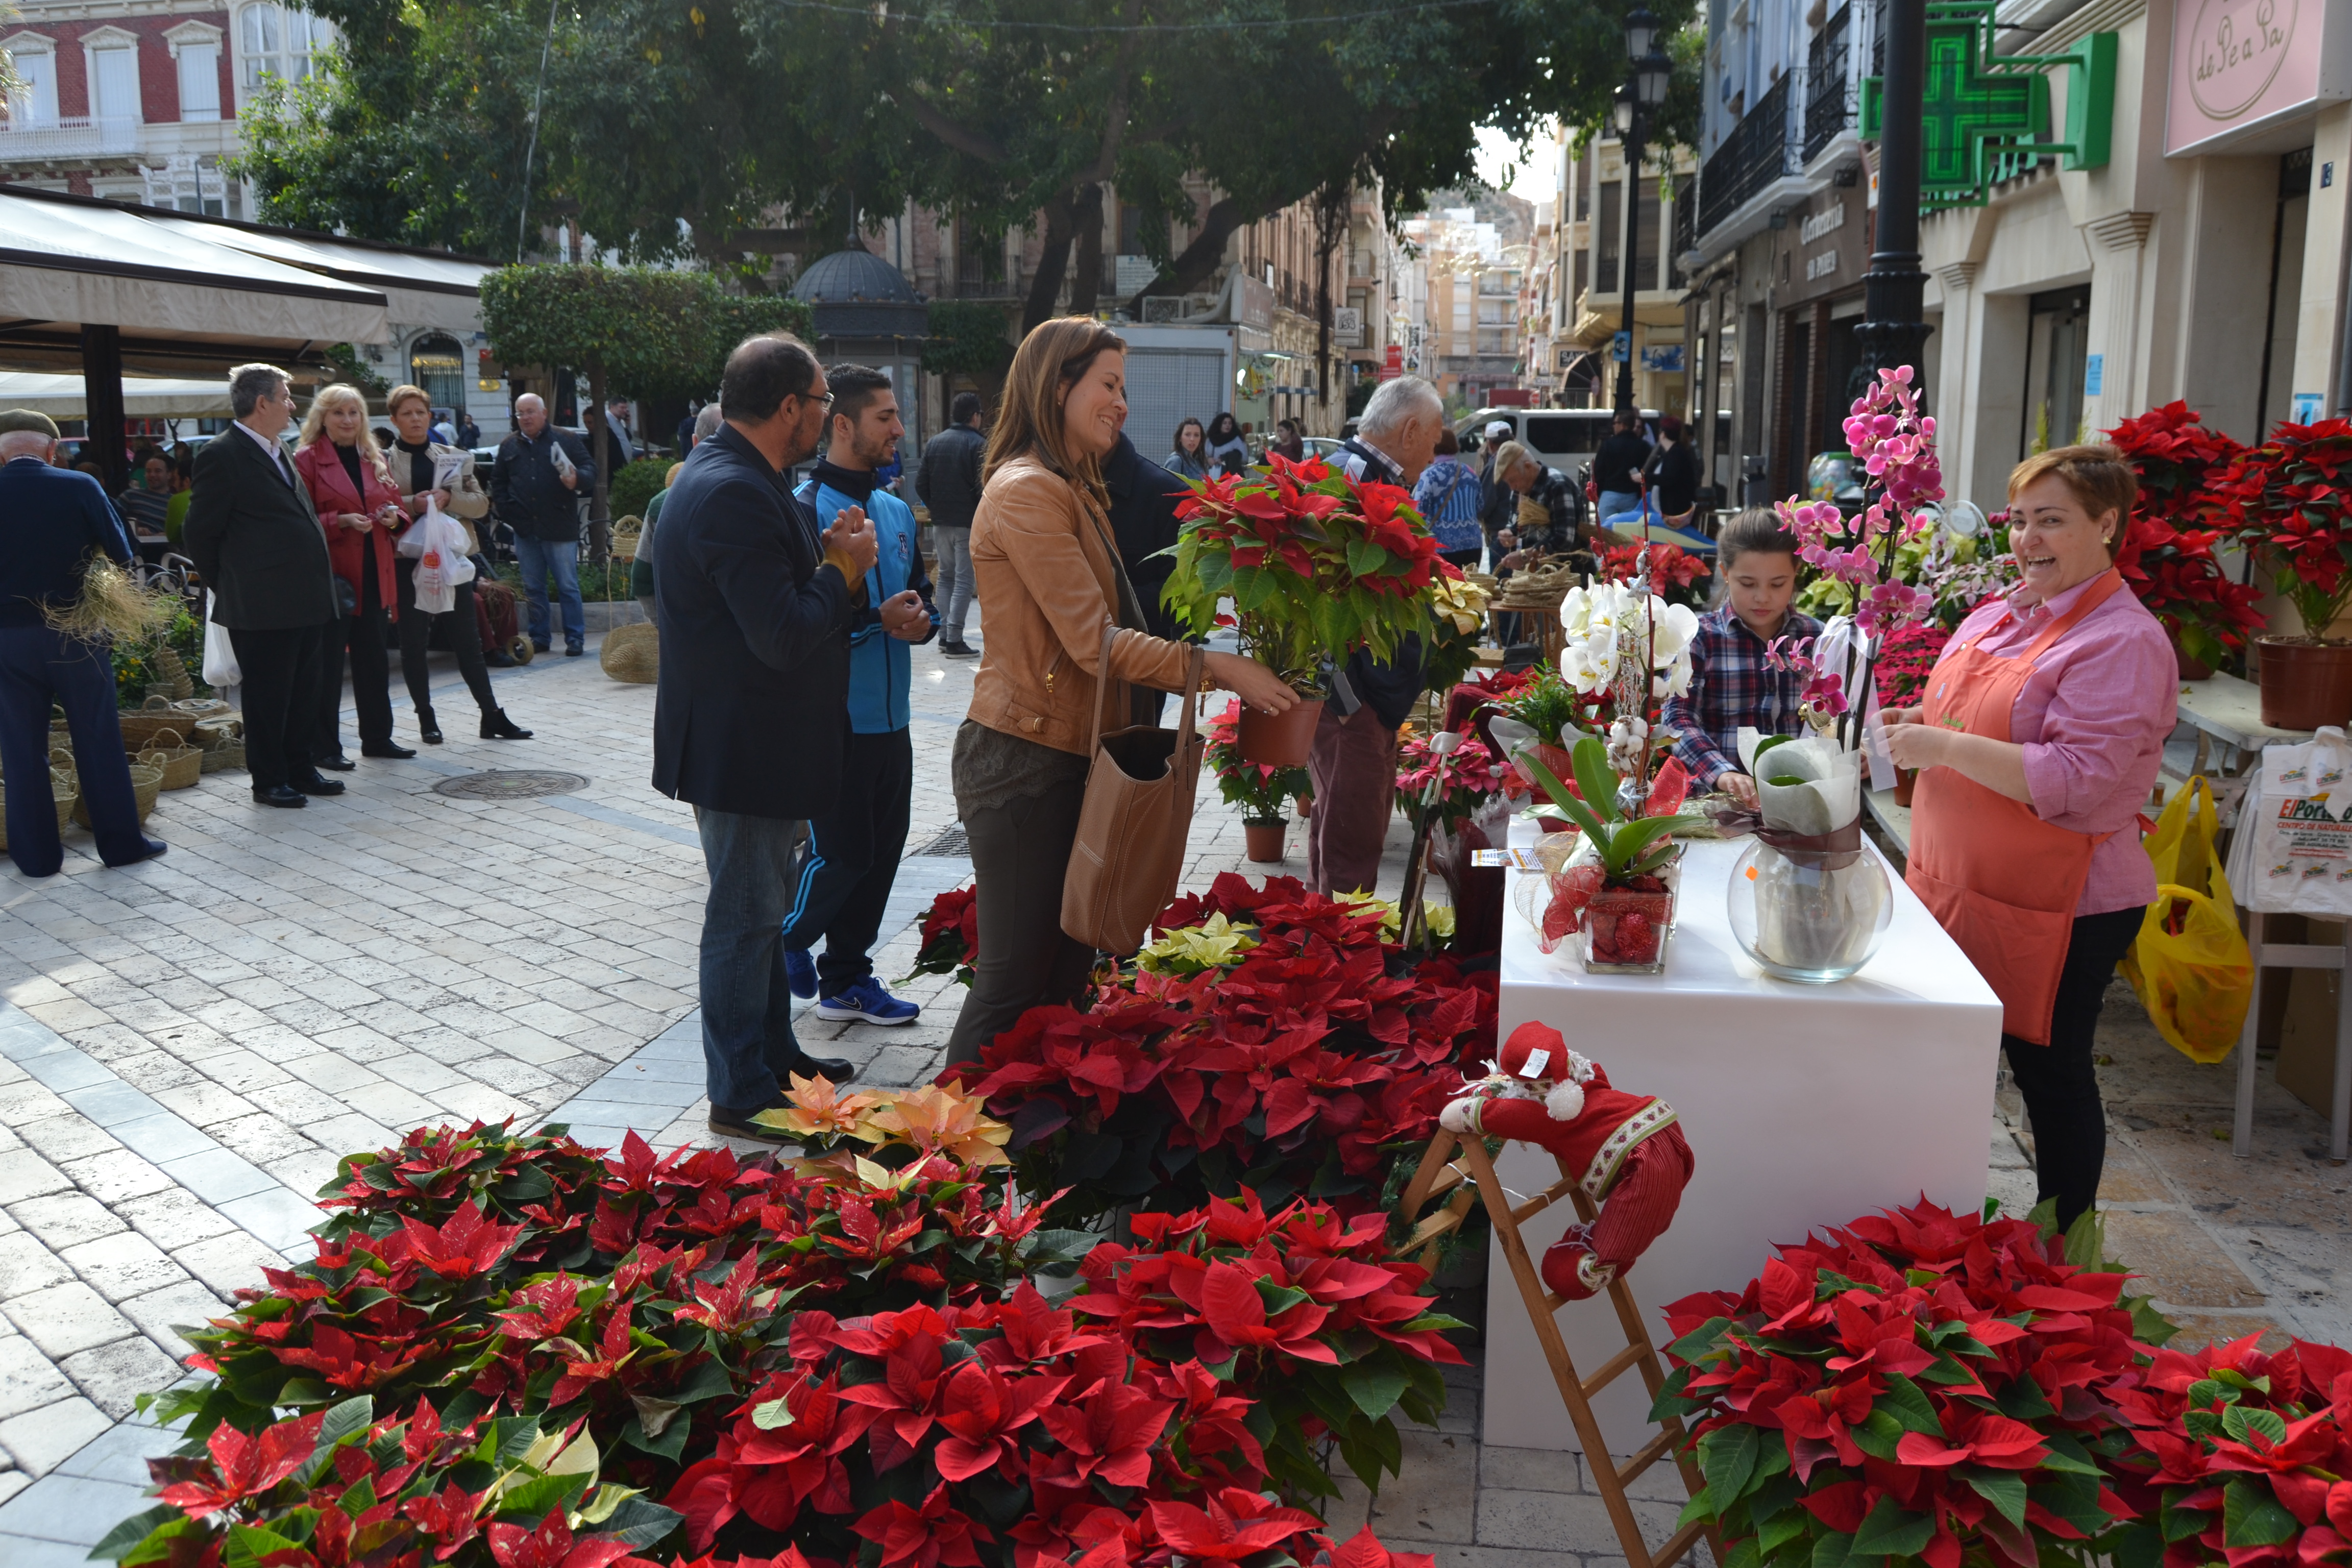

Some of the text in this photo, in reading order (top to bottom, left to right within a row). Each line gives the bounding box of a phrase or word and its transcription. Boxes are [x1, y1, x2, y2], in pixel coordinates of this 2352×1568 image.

[2196, 0, 2284, 82] de Pe a Pa
[1338, 320, 1357, 330] 154
